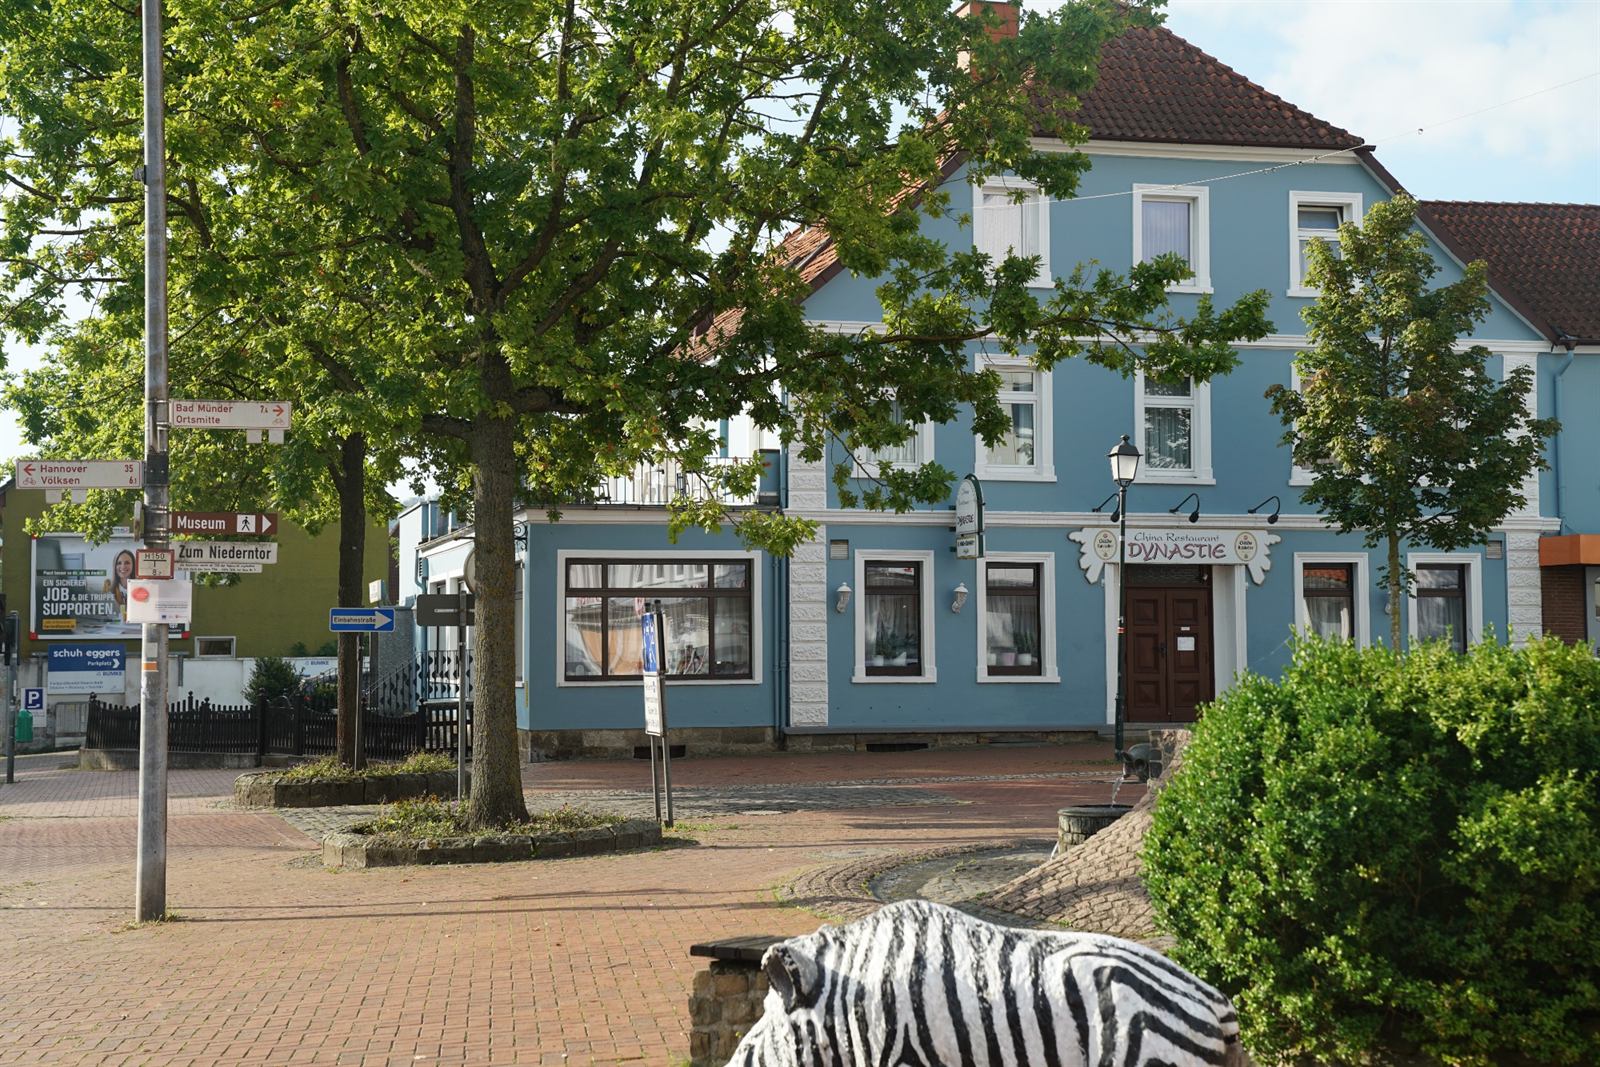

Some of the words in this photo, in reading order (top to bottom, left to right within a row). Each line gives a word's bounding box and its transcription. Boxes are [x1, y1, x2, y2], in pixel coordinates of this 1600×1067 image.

[176, 404, 194, 412] Bad
[198, 404, 233, 413] Münder
[176, 416, 220, 424] Ortsmitte
[40, 464, 88, 473] Hannover
[124, 464, 134, 473] 35
[40, 476, 80, 484] Völksen
[177, 516, 226, 530] Museum
[1134, 532, 1163, 542] China
[1166, 532, 1220, 542] Restaurant
[178, 544, 204, 558] Zum
[209, 545, 272, 560] Niederntor
[1128, 542, 1226, 561] DYNASTIE
[43, 588, 69, 601] JOB
[43, 603, 116, 615] SUPPORTEN.
[53, 648, 82, 658] schuh
[86, 649, 120, 658] eggers
[28, 691, 40, 704] P
